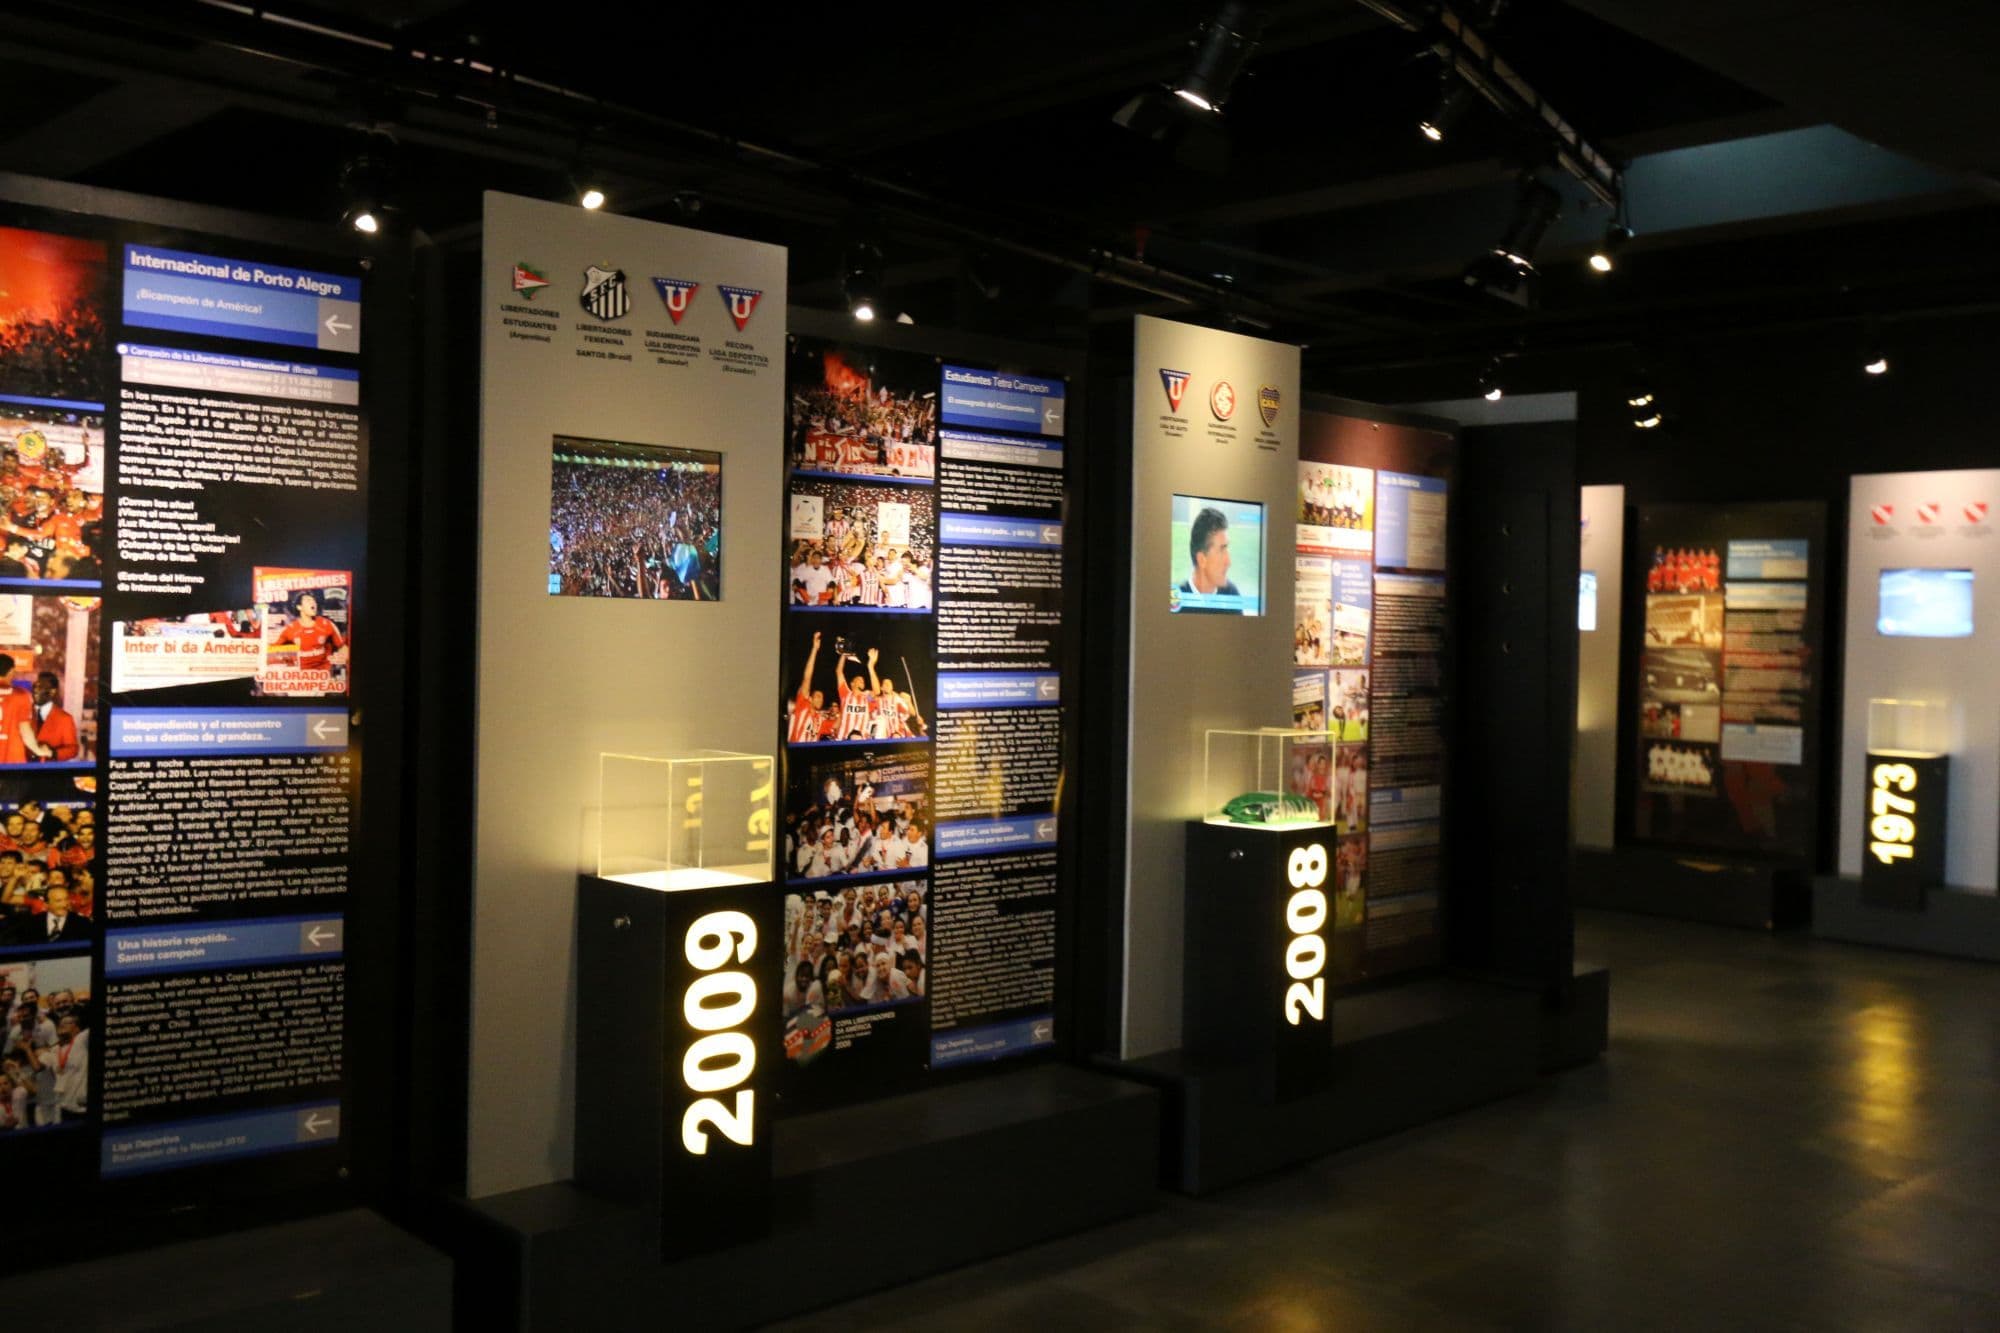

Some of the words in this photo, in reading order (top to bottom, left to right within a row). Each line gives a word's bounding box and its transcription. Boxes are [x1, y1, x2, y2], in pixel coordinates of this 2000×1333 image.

[130, 251, 229, 279] Internacional
[231, 266, 250, 282] de
[253, 269, 292, 288] Porto
[296, 276, 341, 299] Alegre
[136, 288, 199, 308] ¡Bicampeón
[201, 296, 214, 308] de
[216, 298, 262, 314] América!
[501, 305, 560, 318] LIBERTADORES
[504, 318, 557, 331] ESTUDIANTES
[576, 323, 632, 336] LIBERTADORES
[576, 349, 605, 359] SANTOS
[945, 370, 991, 386] Estudiantes
[993, 377, 1012, 389] Tetra
[258, 575, 346, 590] LIBERTADORES
[257, 590, 288, 603] 2010
[125, 640, 159, 654] Inter
[164, 640, 176, 653] bi
[182, 640, 198, 653] da
[203, 640, 260, 654] América
[122, 720, 198, 732] Independiente
[200, 722, 207, 731] y
[209, 720, 220, 728] el
[221, 720, 281, 729] reencuentro
[159, 732, 199, 742] destino
[201, 732, 214, 741] de
[1871, 762, 1917, 864] 1973
[1285, 844, 1327, 1025] 2008
[117, 939, 140, 950] Una
[141, 936, 182, 948] historia
[117, 950, 154, 962] Santos
[157, 946, 204, 961] campeón
[682, 910, 758, 1155] 2009
